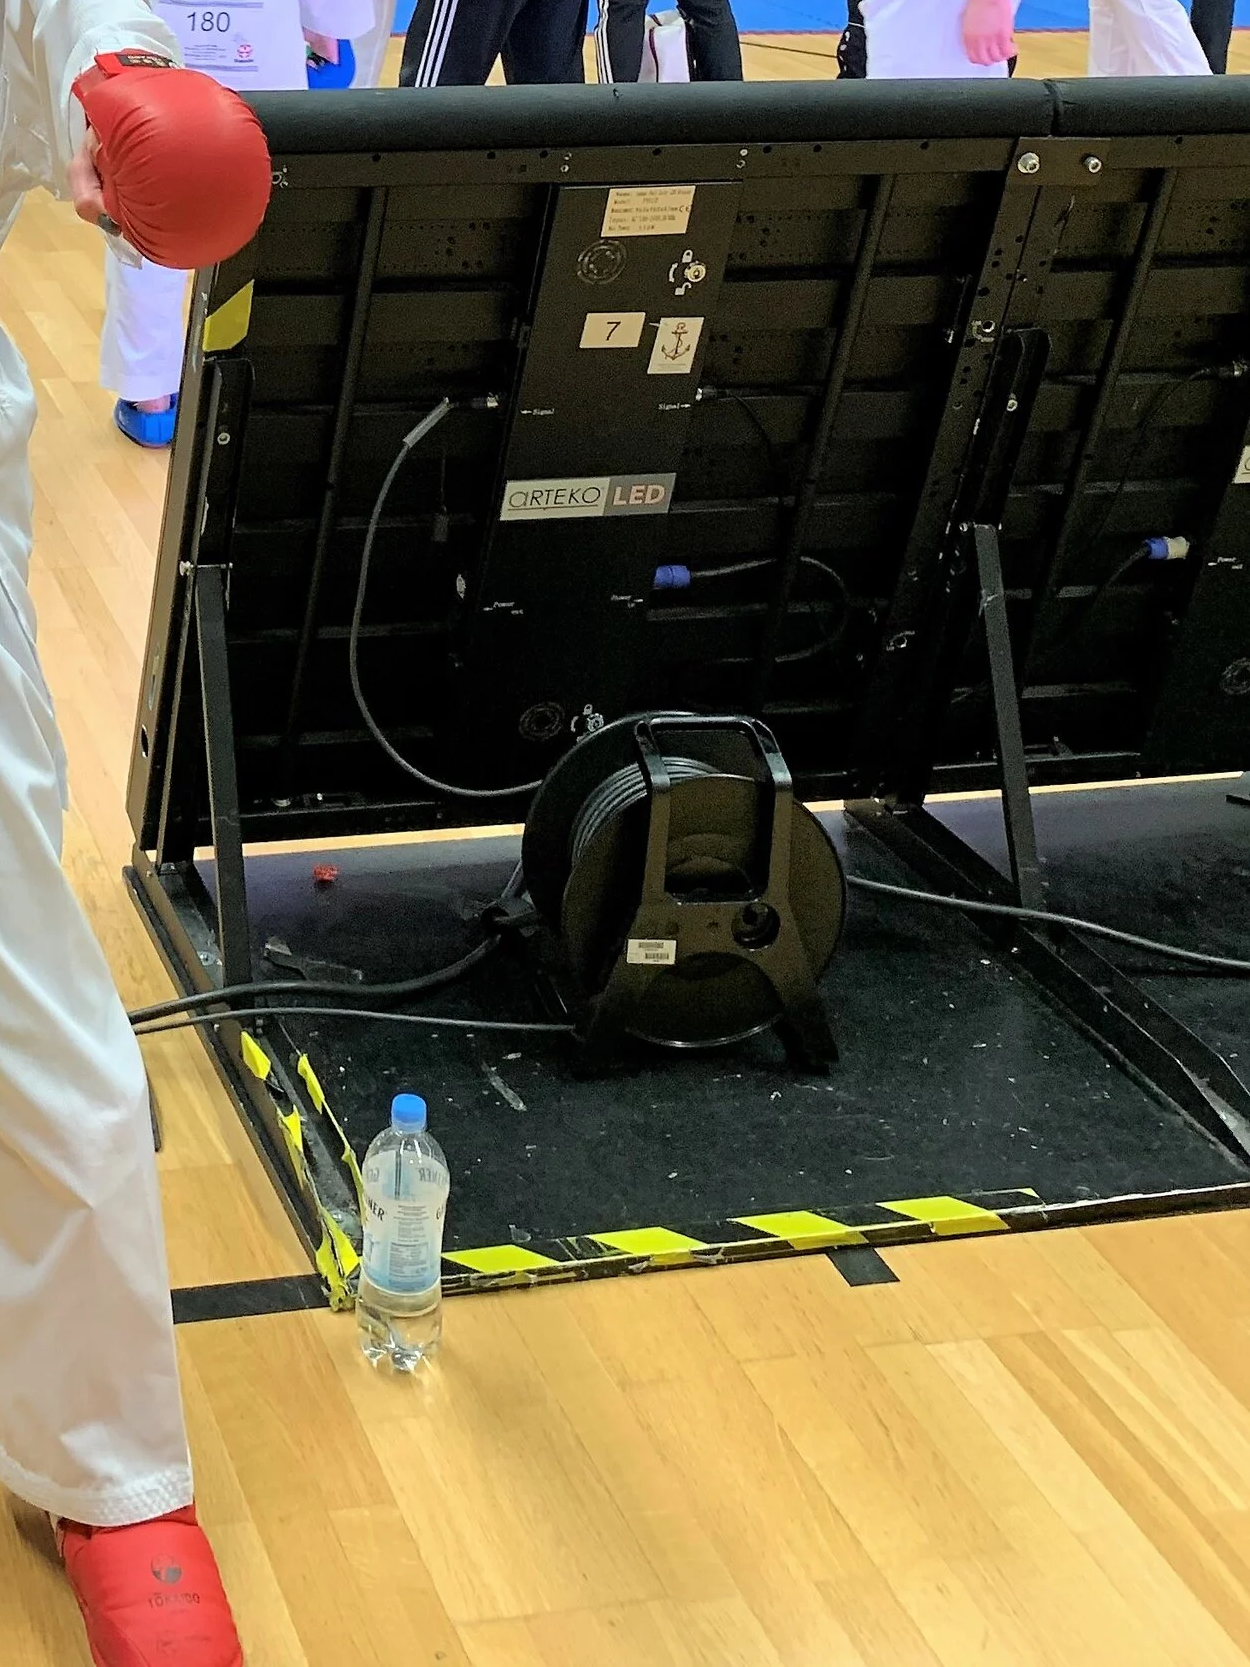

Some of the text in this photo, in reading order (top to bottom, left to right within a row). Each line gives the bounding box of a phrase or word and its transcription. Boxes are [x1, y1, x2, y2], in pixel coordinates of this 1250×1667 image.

[186, 11, 231, 33] 180
[606, 321, 622, 341] 7
[658, 403, 680, 411] Signal
[612, 483, 666, 506] LED
